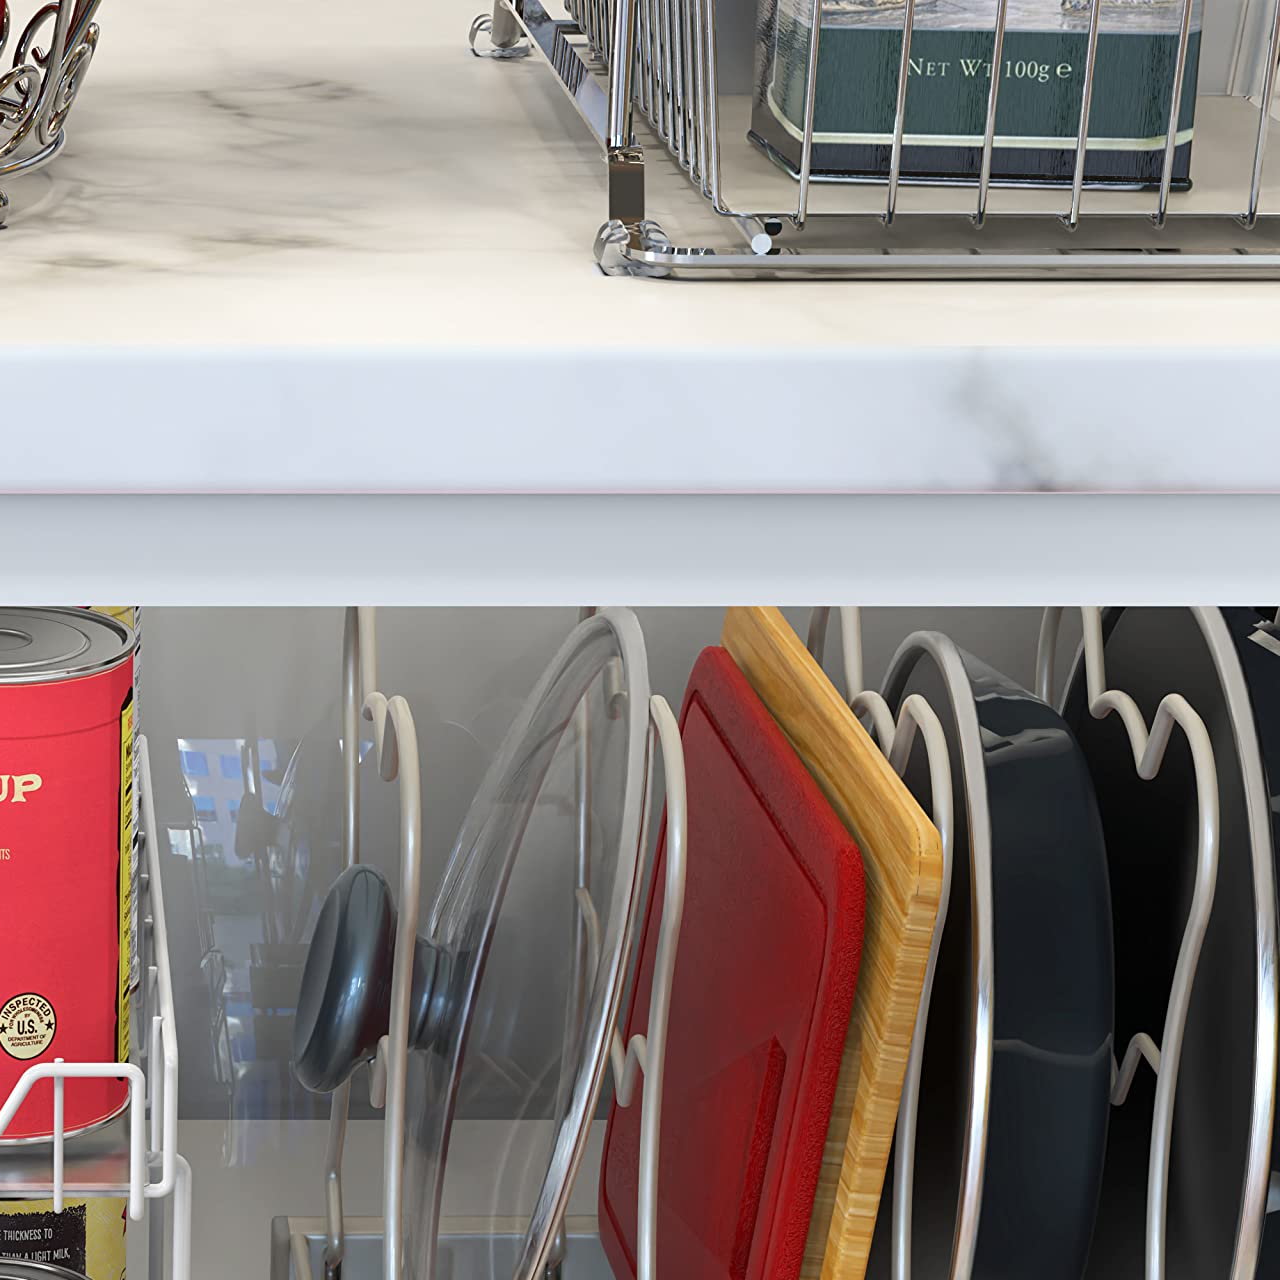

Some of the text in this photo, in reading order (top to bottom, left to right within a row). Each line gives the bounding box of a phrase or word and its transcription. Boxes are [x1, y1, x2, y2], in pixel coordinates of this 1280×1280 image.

[1004, 60, 1050, 83] 100g
[1, 997, 52, 1020] INSPECTED
[17, 1018, 38, 1035] U.S.
[8, 1034, 39, 1042] DEPARTMENT
[11, 1039, 44, 1047] AGRICULTURE
[3, 1228, 42, 1241] THICKNESS
[44, 1228, 53, 1239] TO
